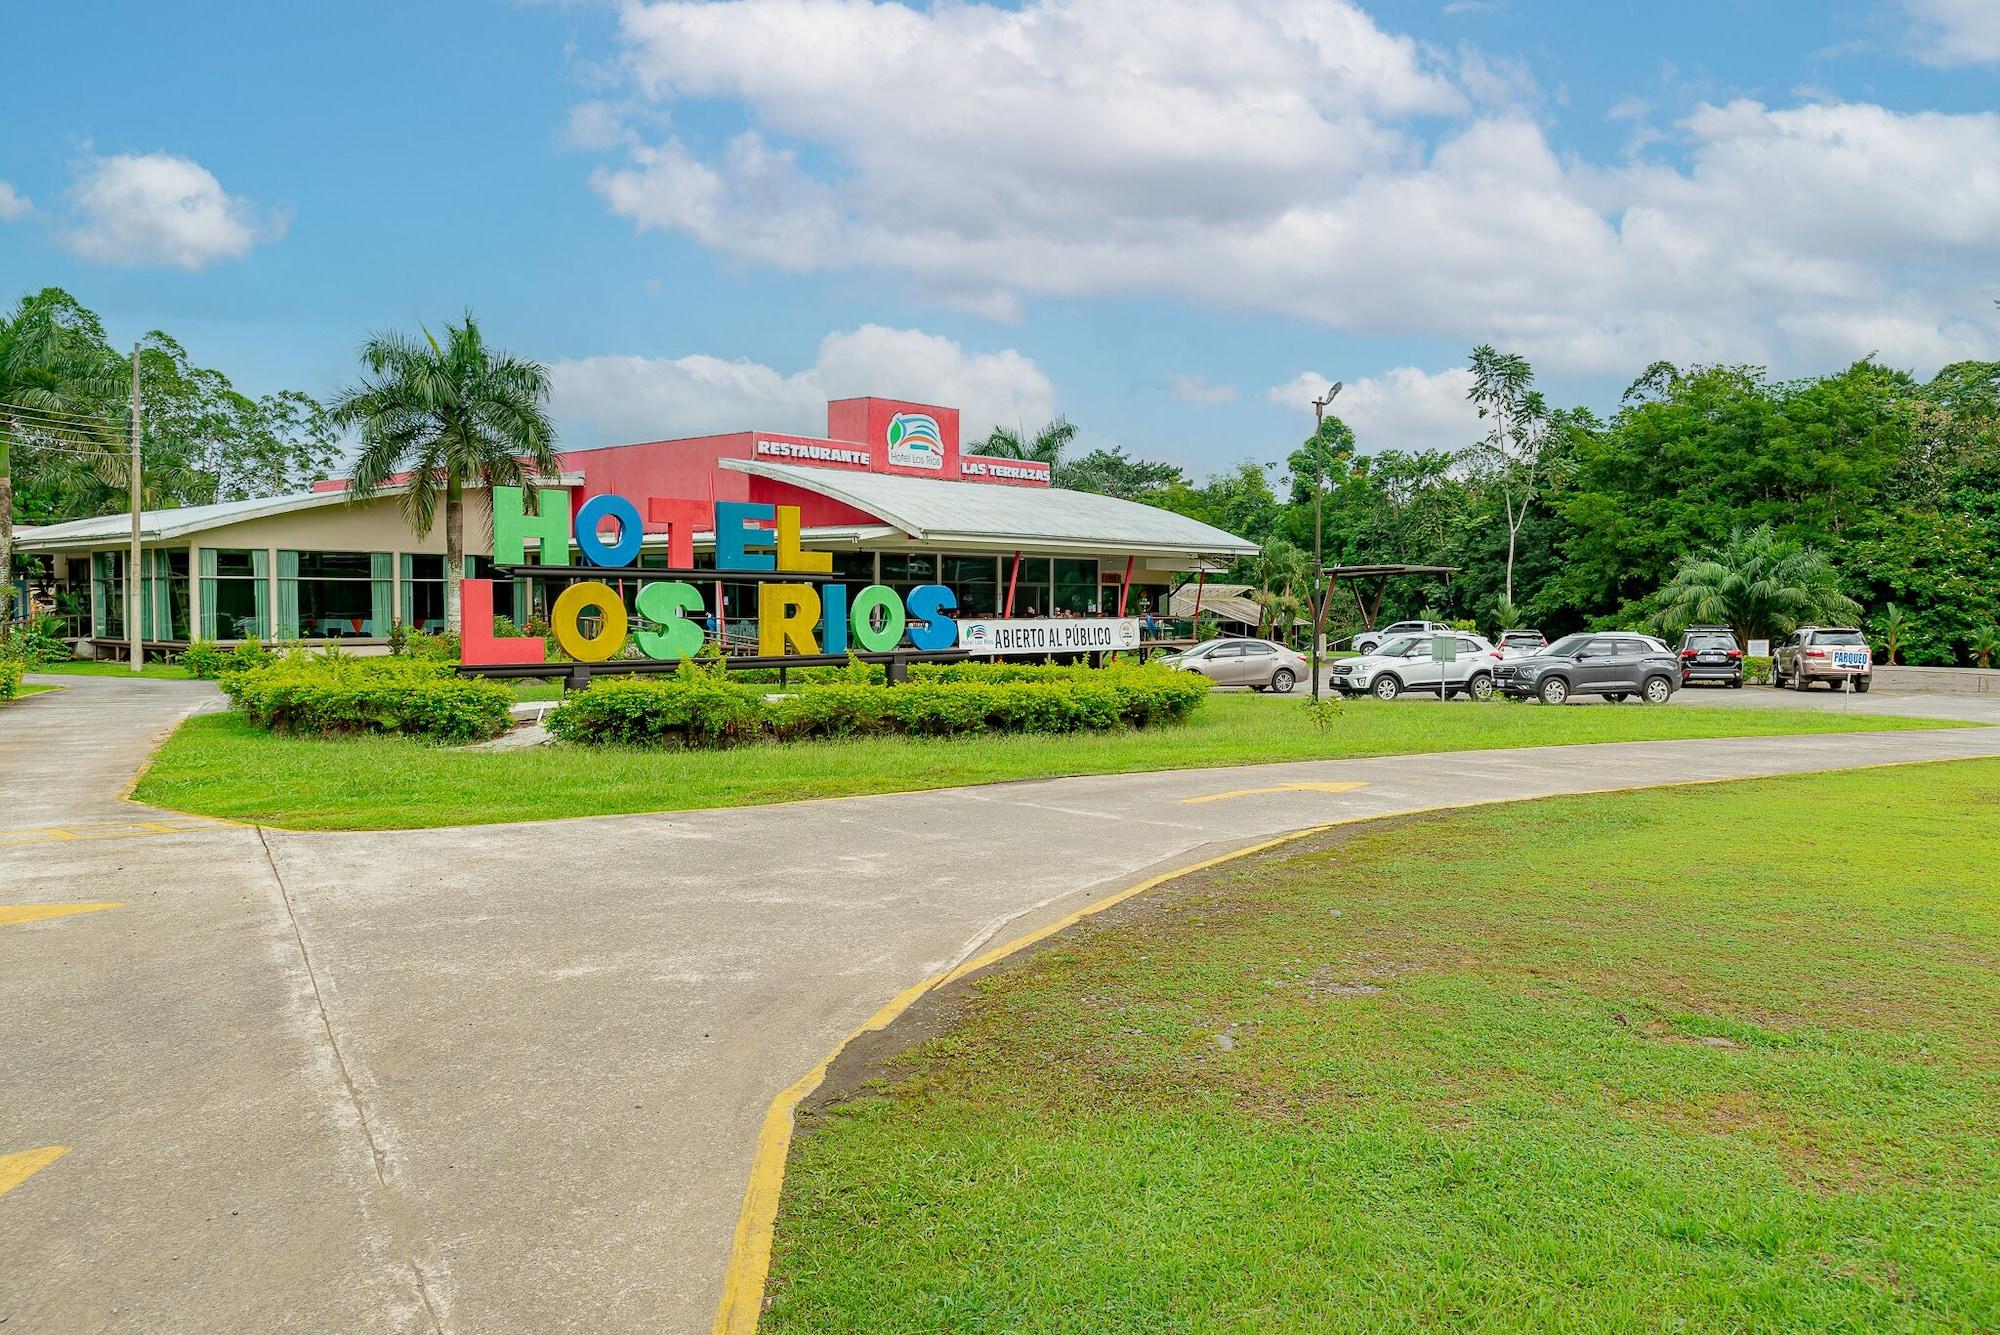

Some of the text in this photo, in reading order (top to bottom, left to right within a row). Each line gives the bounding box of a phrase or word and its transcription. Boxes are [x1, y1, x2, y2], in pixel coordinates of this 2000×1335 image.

[757, 440, 870, 465] RESTAURANTE
[891, 451, 911, 463] Hotel
[912, 454, 925, 465] Los
[961, 462, 1050, 481] LAS TERRAZAS
[492, 486, 833, 572] HOTEL
[460, 579, 958, 665] LOS RIOS
[995, 624, 1111, 649] ABIERTO AL PÚBLICO
[1834, 651, 1868, 665] PARQUEO
